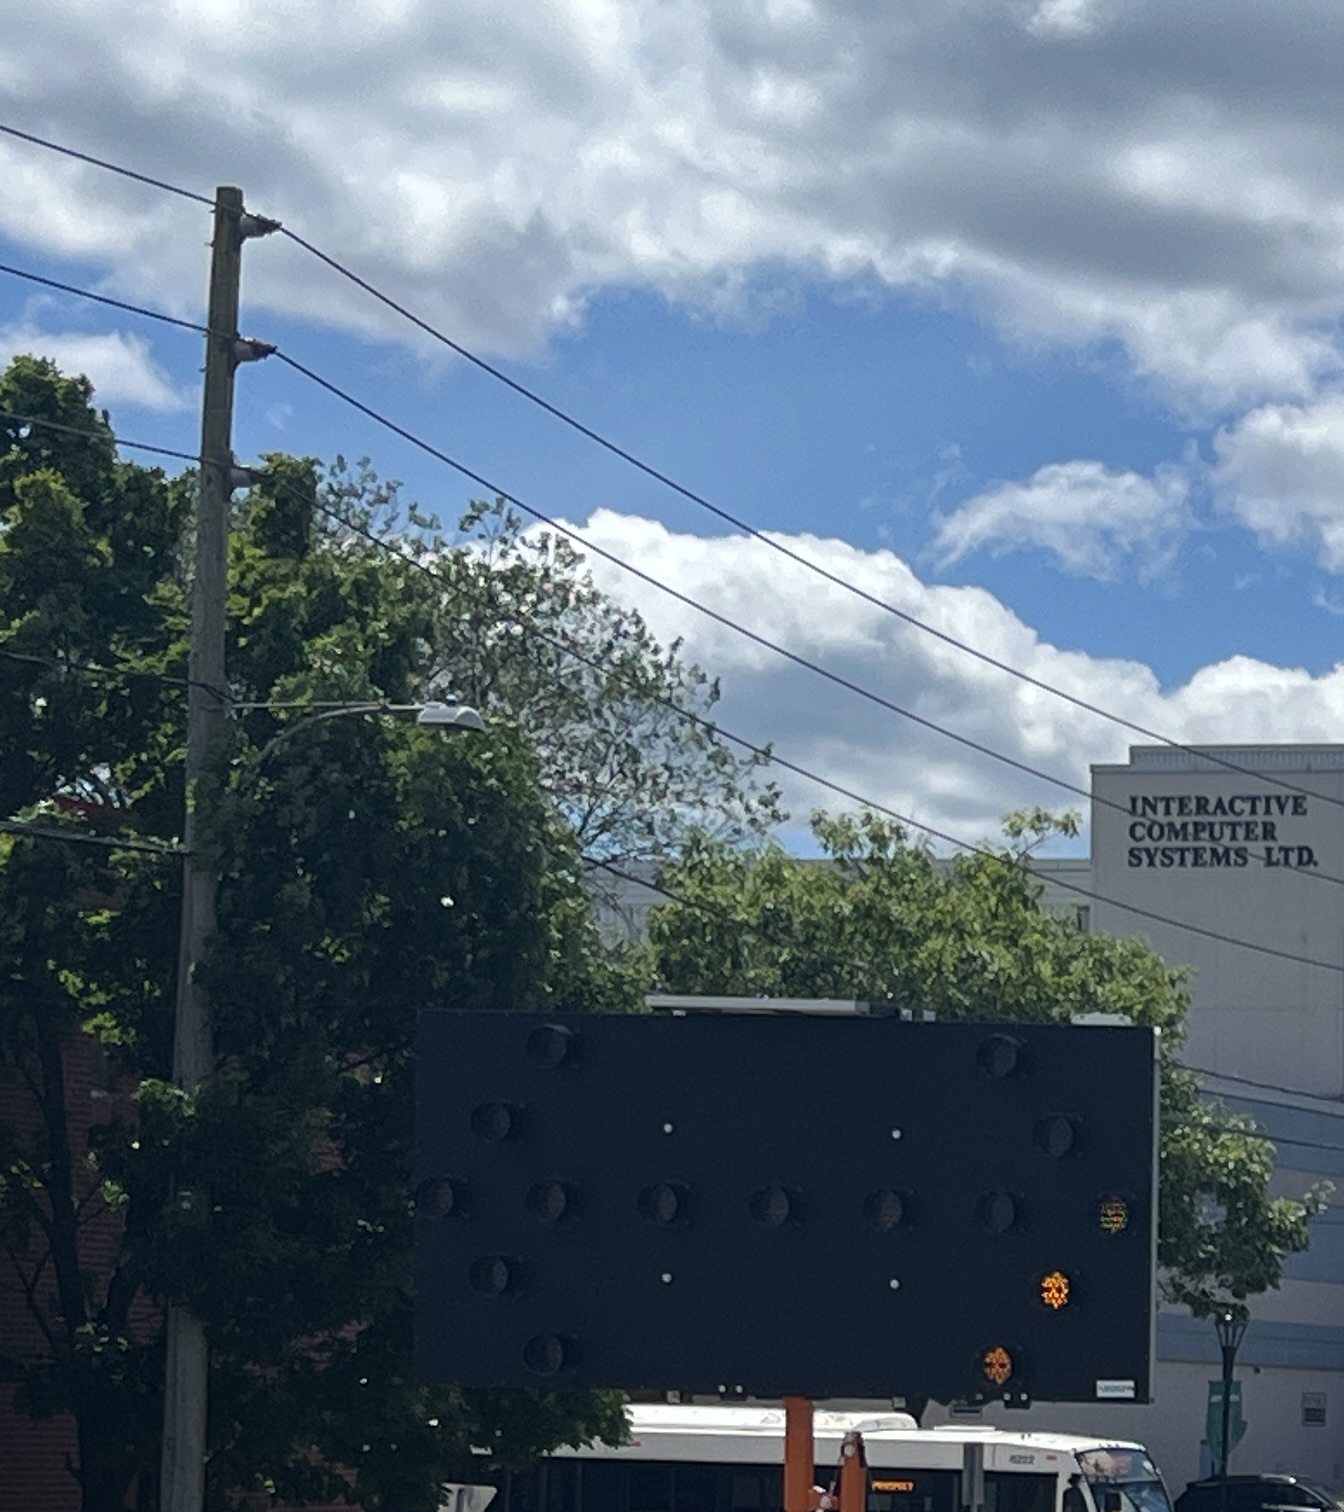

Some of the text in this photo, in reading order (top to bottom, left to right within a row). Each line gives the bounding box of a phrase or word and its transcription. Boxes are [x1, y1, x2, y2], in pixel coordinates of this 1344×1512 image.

[1129, 795, 1308, 817] INTERACTIVE
[1129, 820, 1278, 842] COMPUTER
[1128, 845, 1319, 868] SYSTEMS LTD.
